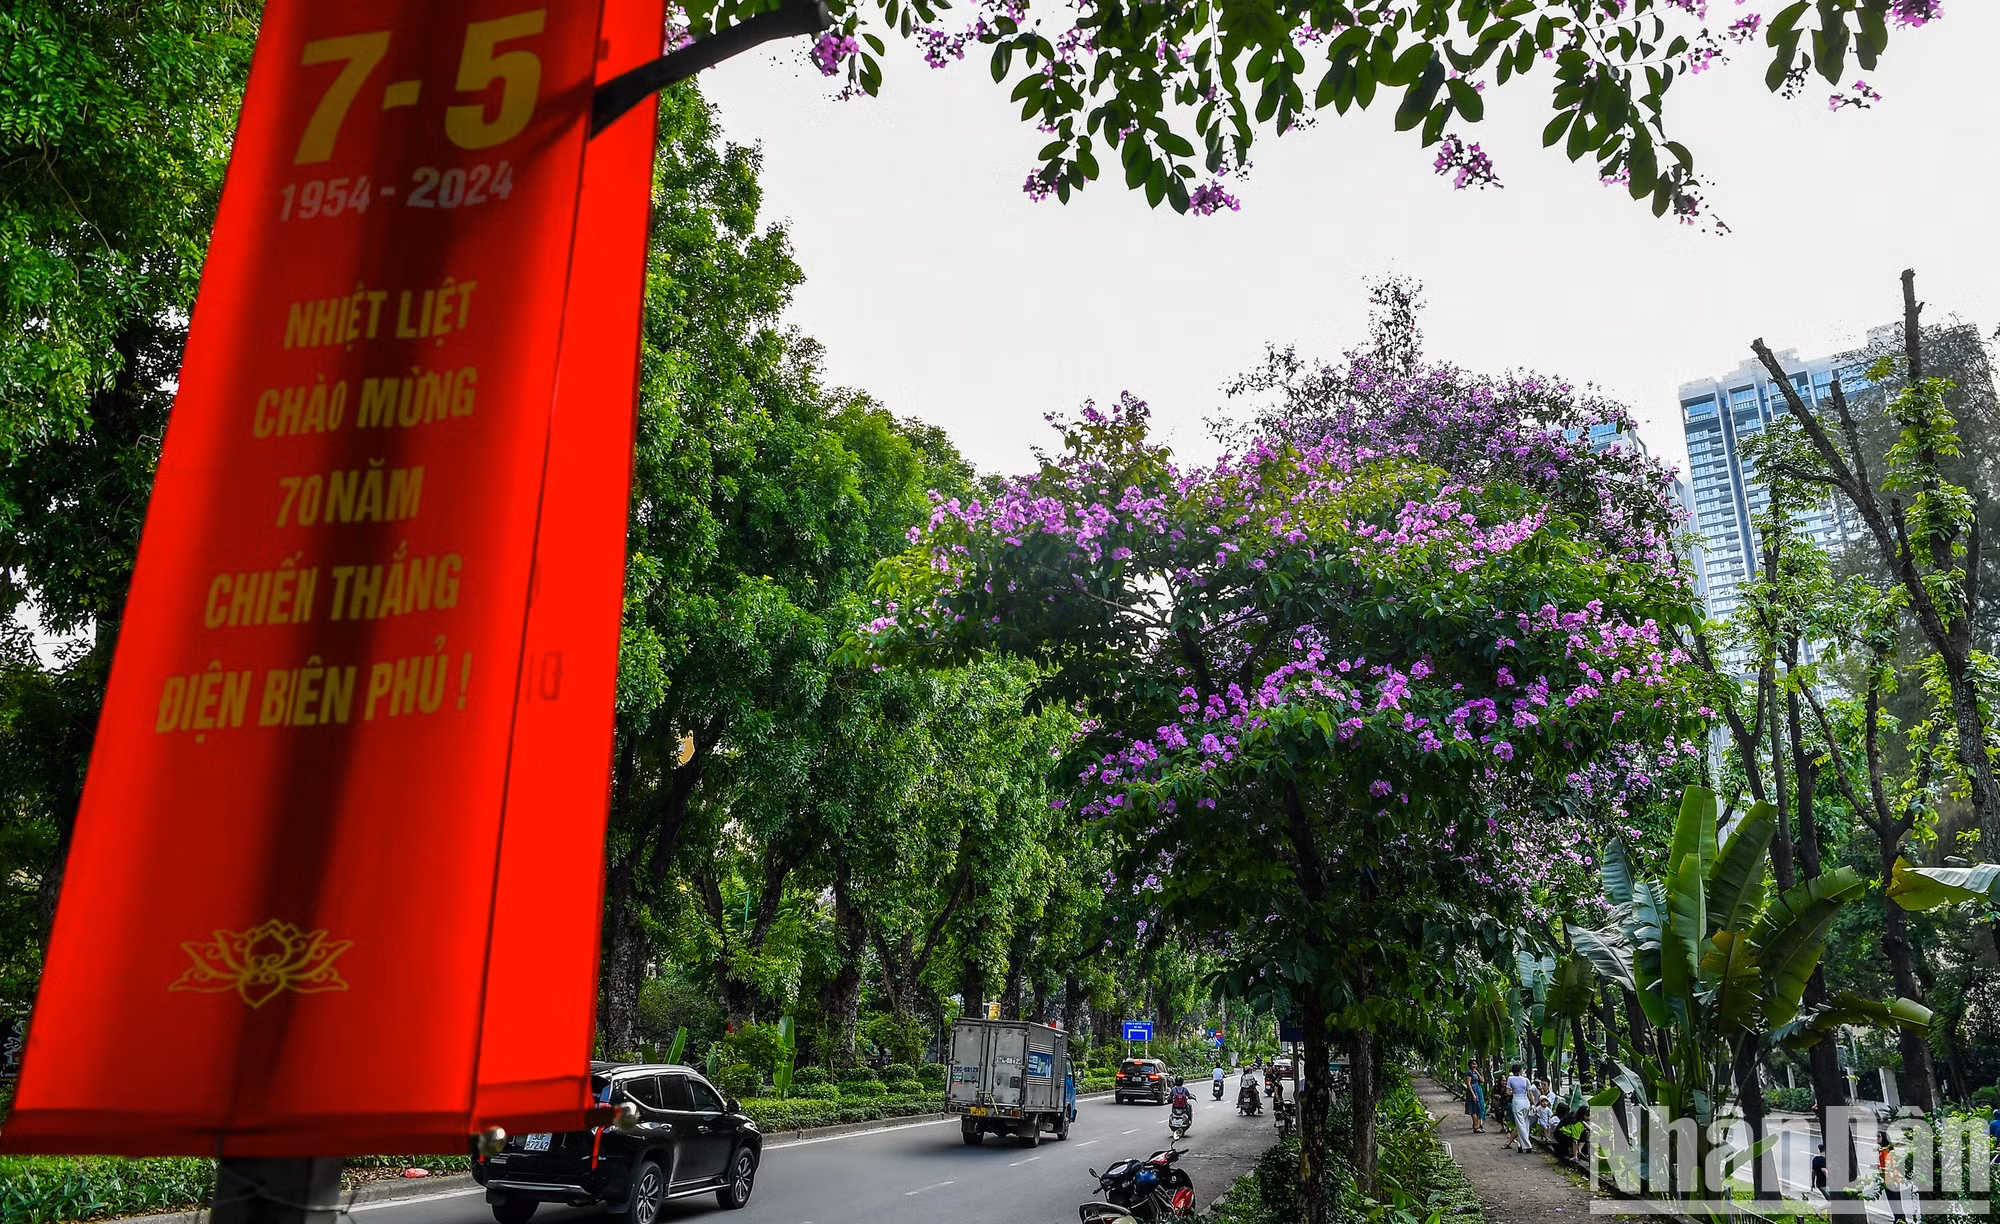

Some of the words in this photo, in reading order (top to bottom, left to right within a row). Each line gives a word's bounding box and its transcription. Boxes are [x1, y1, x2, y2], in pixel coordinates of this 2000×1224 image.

[280, 174, 371, 222] 1954
[406, 160, 514, 210] 2024
[283, 281, 388, 353] NHIỆT
[396, 276, 478, 347] LIỆT
[252, 372, 347, 439] CHÀO
[357, 365, 479, 429] MỪNG
[203, 551, 319, 630] CHIẾN
[330, 540, 464, 622] THẮNG
[154, 659, 254, 744] ĐIỆN
[257, 655, 358, 728] BIÊN
